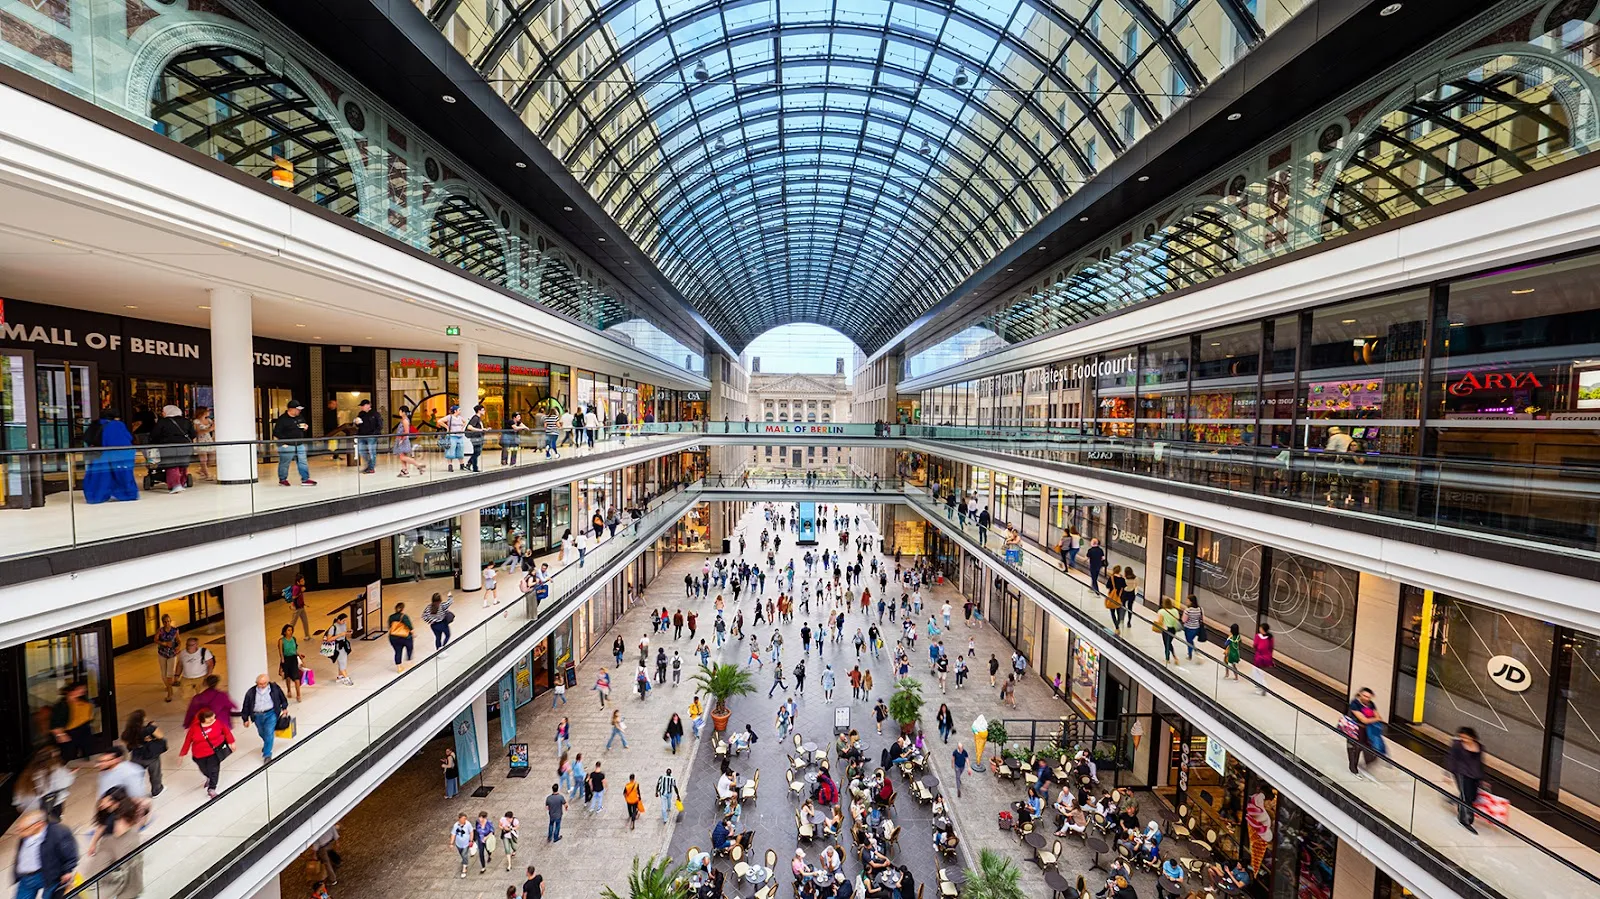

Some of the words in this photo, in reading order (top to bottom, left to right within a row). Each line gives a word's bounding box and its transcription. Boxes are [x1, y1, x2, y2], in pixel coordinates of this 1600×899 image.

[0, 322, 78, 347] MALL
[85, 332, 121, 351] OF
[130, 337, 199, 359] BERLIN
[400, 357, 438, 369] SPACE
[1031, 365, 1068, 389] greatest
[1072, 353, 1134, 380] Foodcourt
[1448, 371, 1543, 396] ARYA
[794, 425, 807, 433] OF
[810, 425, 844, 434] BERLIN
[1493, 663, 1526, 684] JD
